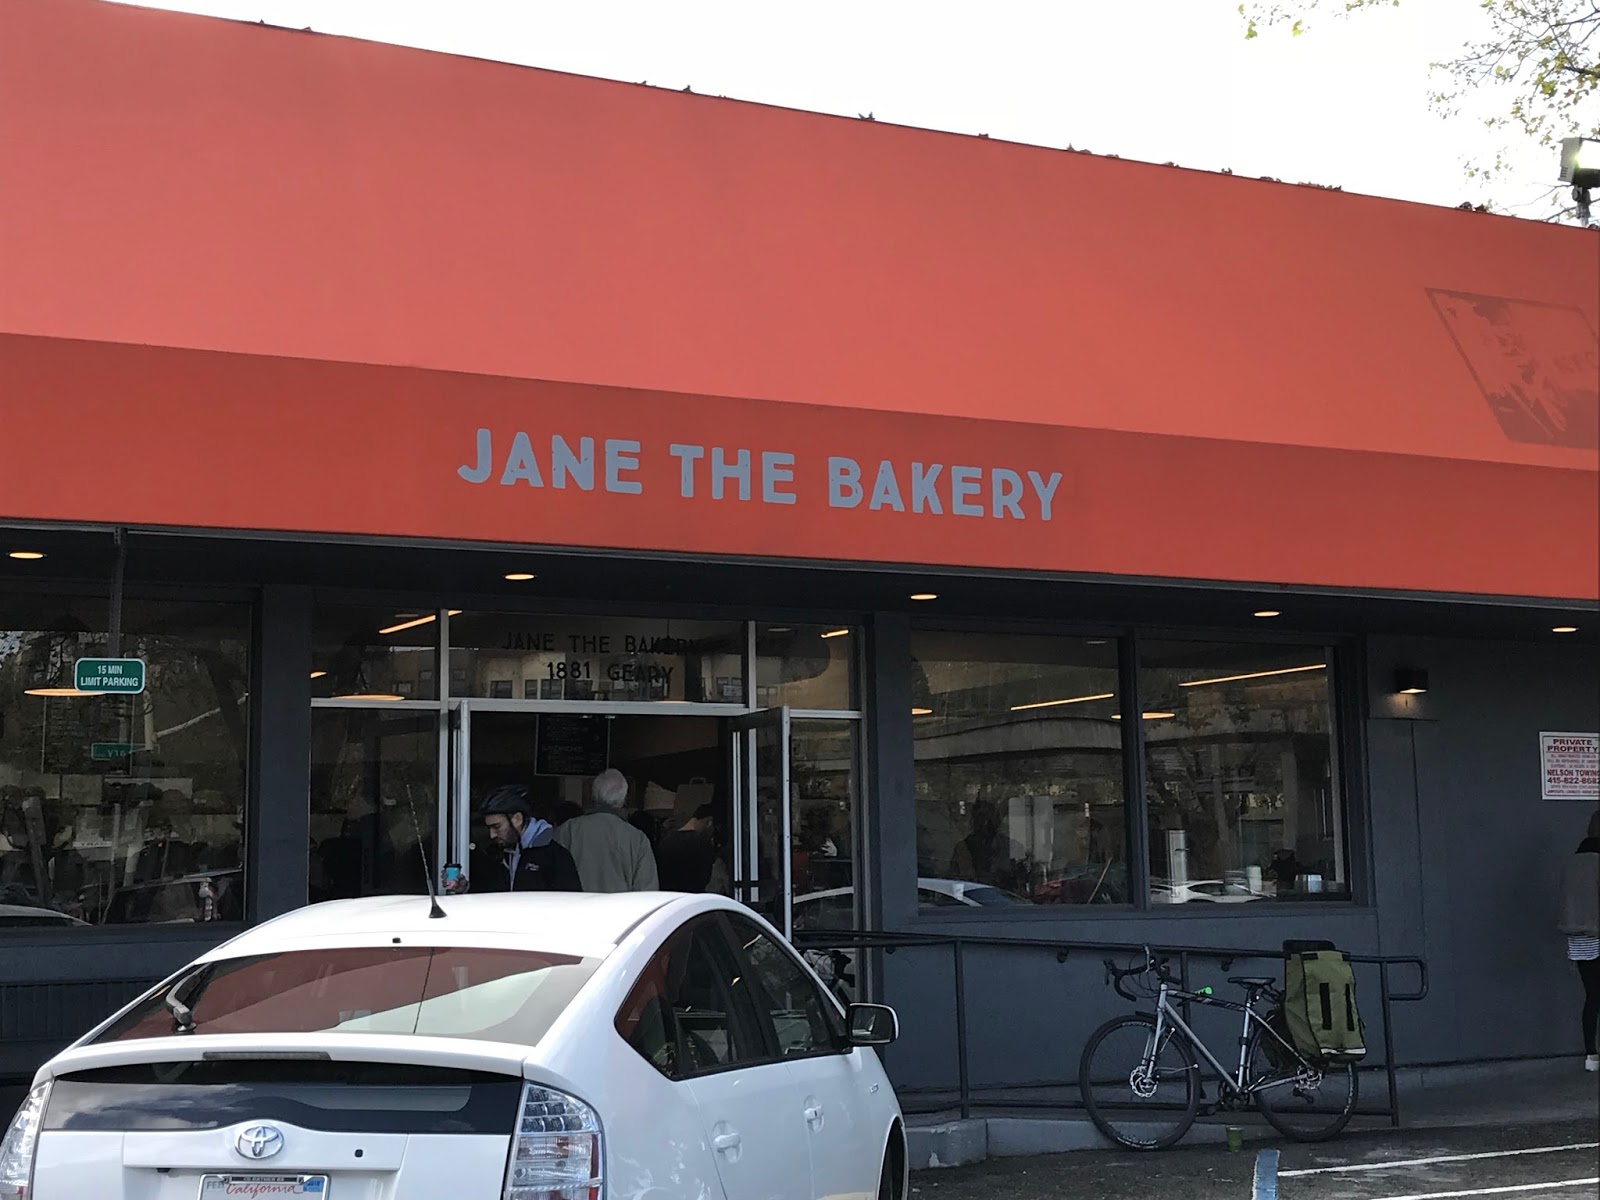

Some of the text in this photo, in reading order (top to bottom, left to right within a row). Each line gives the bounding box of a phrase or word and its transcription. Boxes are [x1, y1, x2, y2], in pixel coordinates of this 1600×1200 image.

[457, 428, 1063, 521] JANE THE BAKERY
[501, 632, 555, 651] JANE
[568, 635, 611, 654] THE
[97, 665, 123, 675] 15 MIN
[547, 661, 674, 684] 1881 GEARY
[80, 677, 139, 687] LIMIT PARKING
[226, 1184, 303, 1199] California
